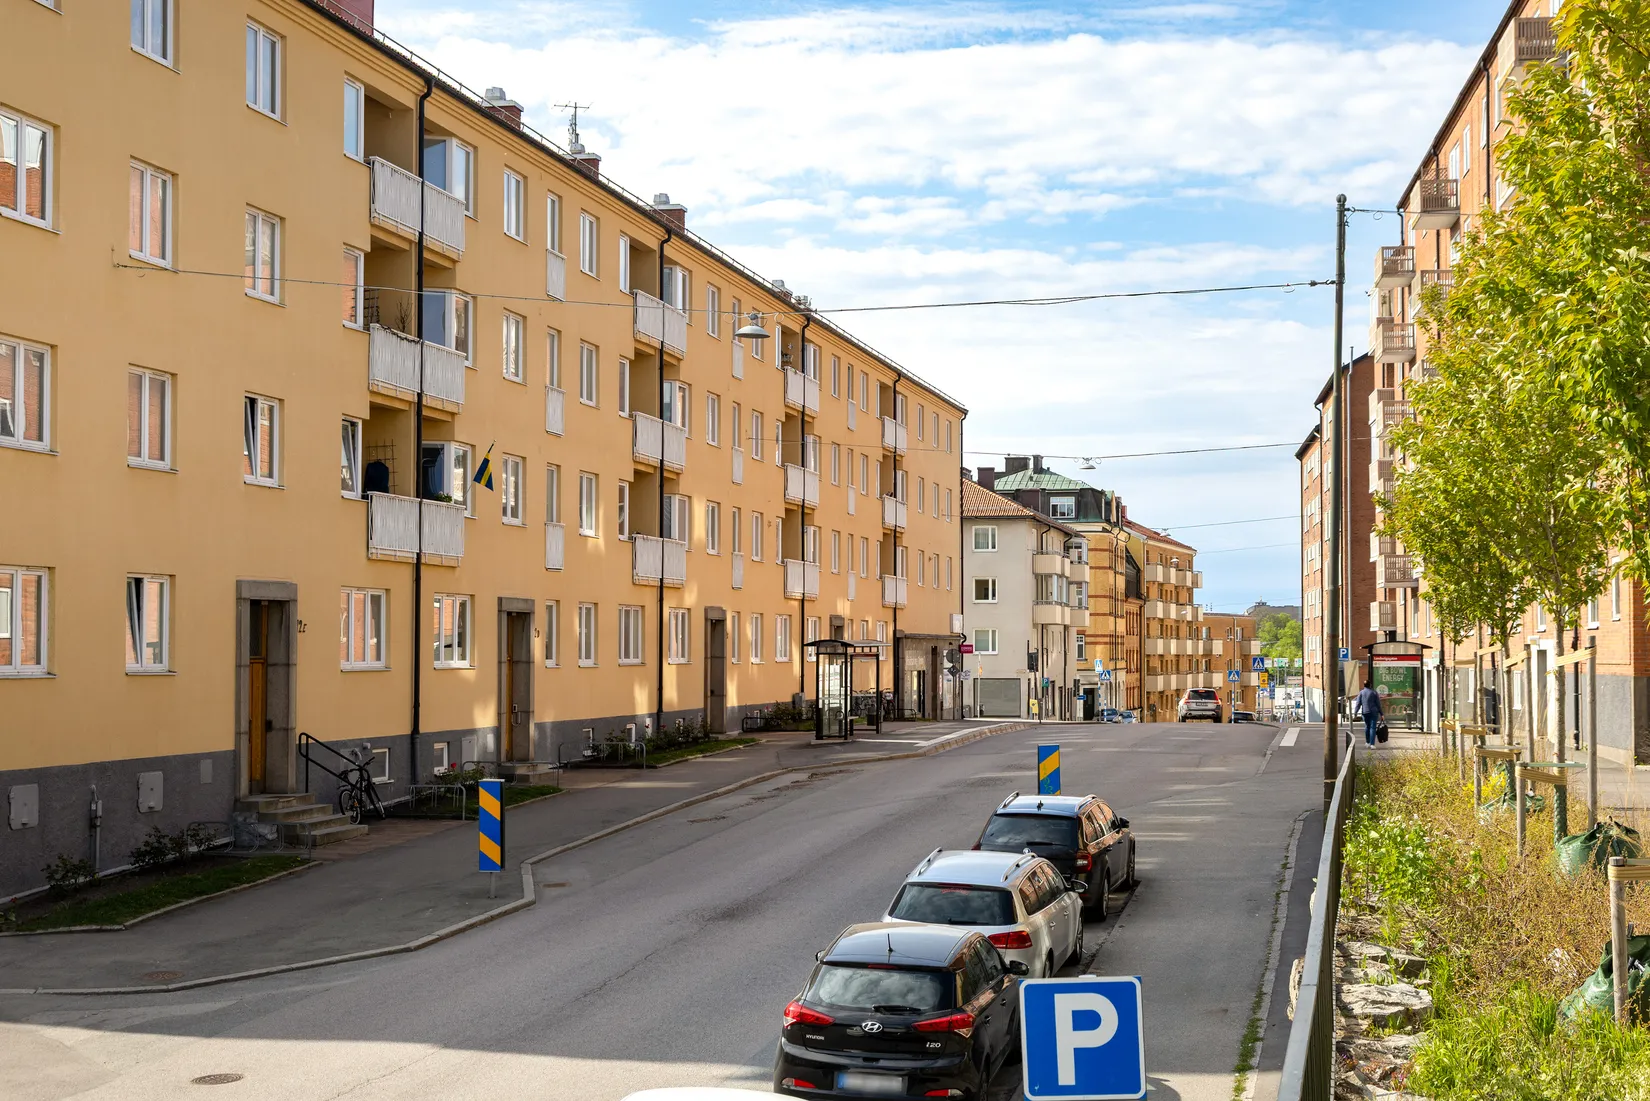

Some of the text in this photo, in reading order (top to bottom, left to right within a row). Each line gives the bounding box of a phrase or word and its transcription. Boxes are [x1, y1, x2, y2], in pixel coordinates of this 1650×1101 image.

[1340, 648, 1347, 658] P
[1382, 674, 1404, 682] ENERGY
[1054, 992, 1119, 1086] P
